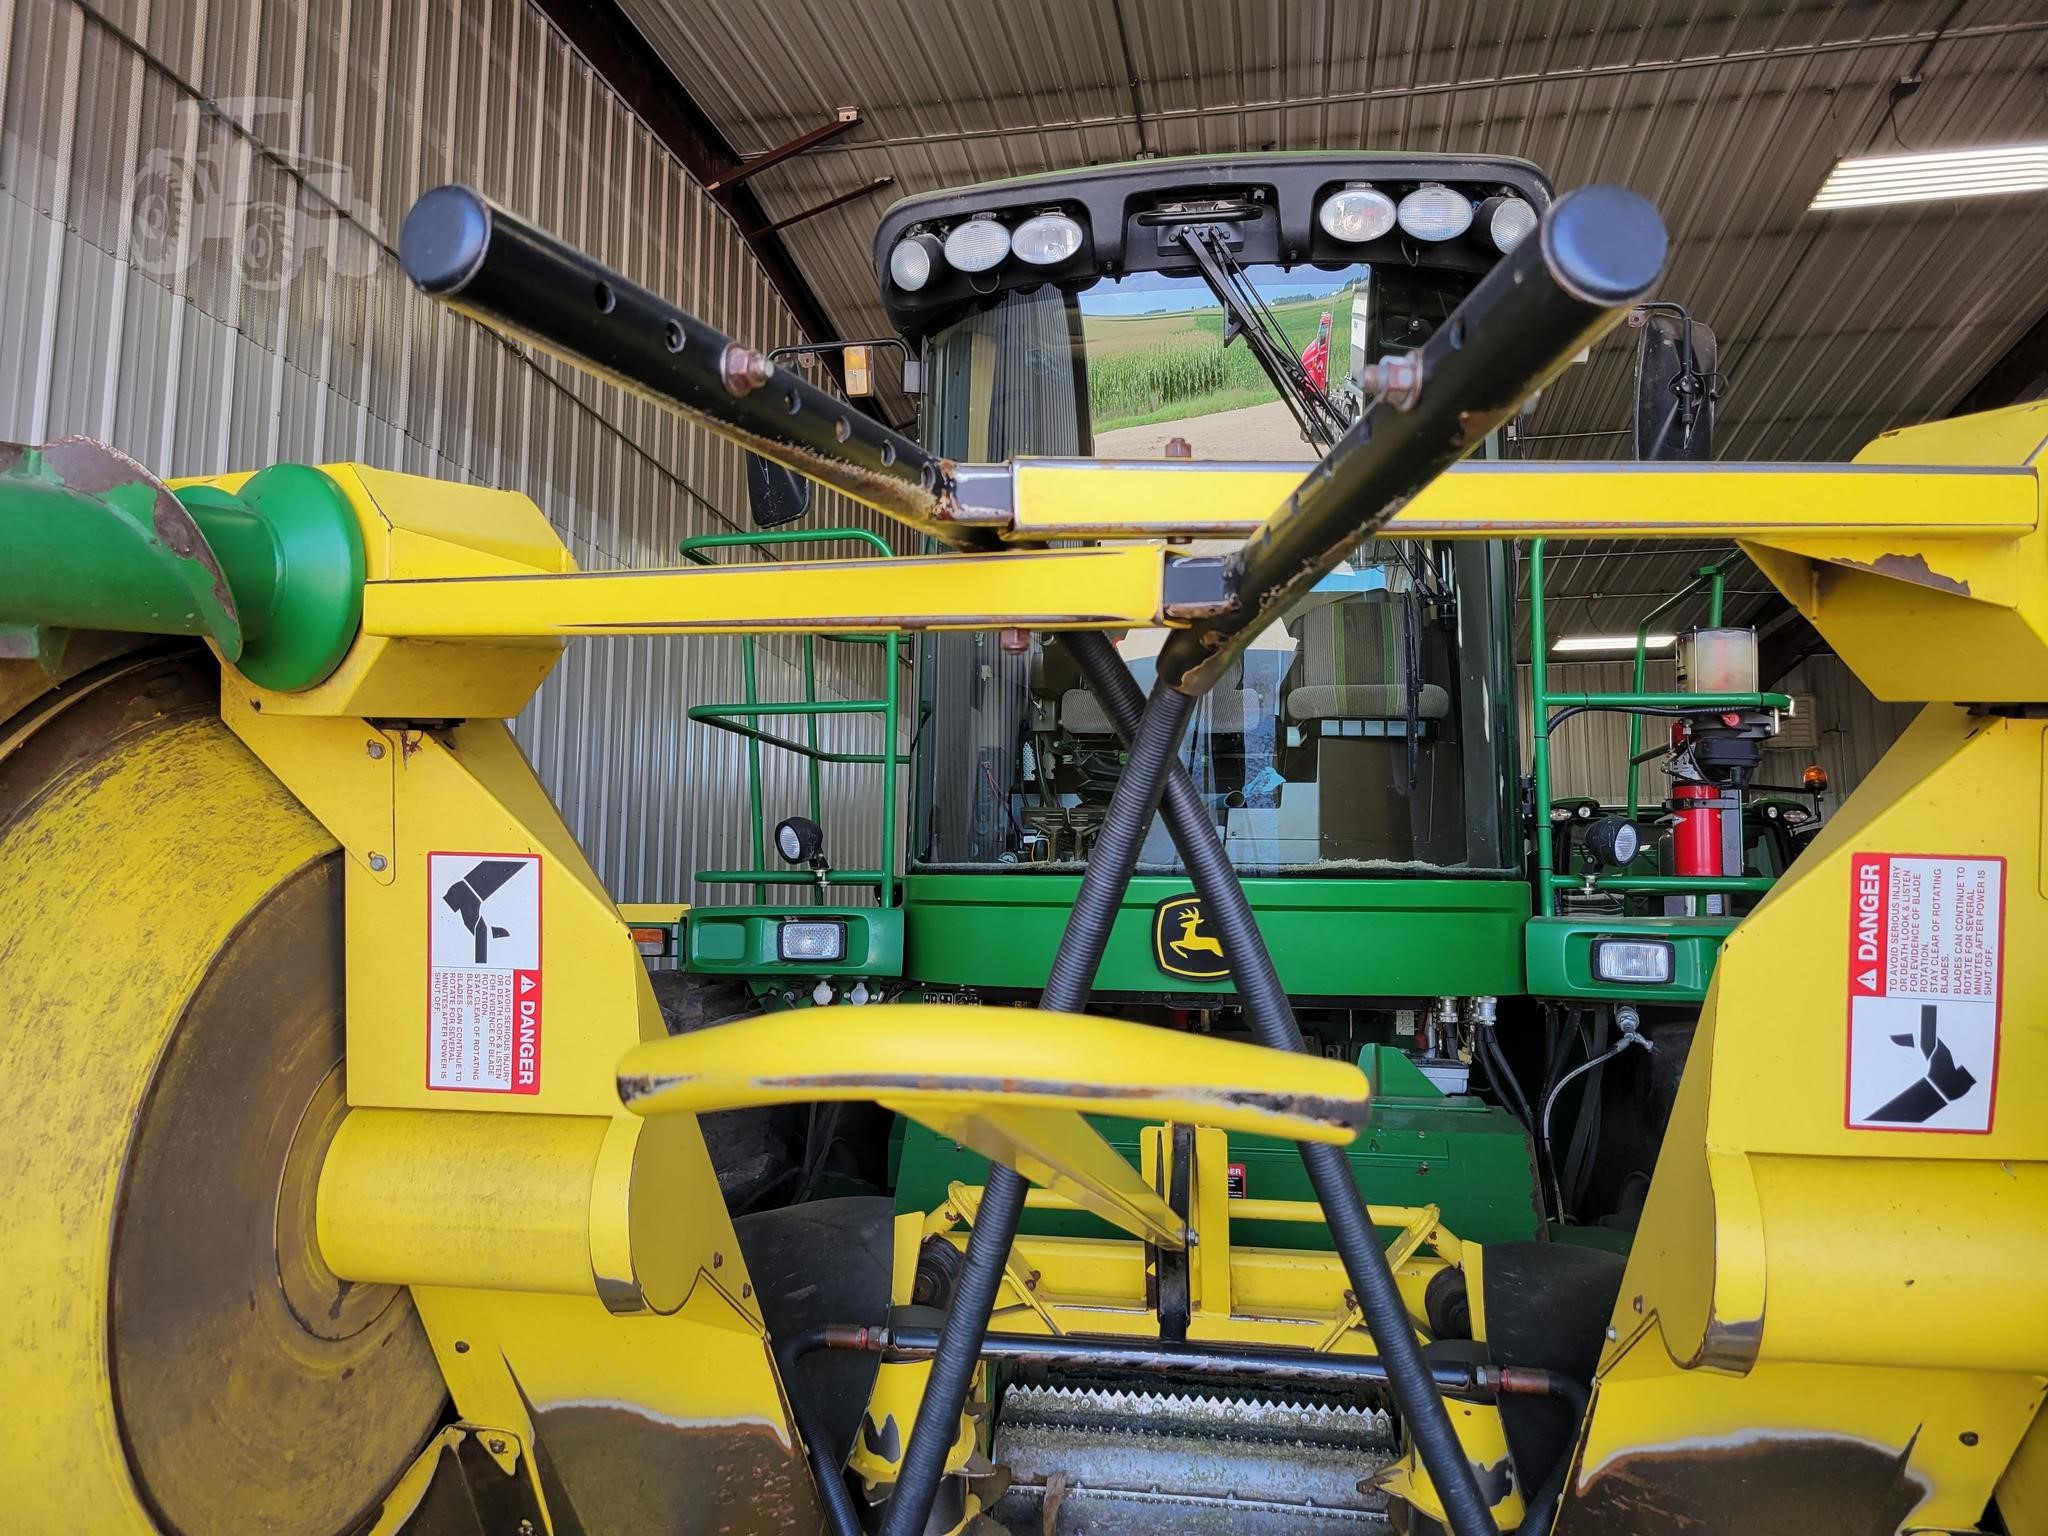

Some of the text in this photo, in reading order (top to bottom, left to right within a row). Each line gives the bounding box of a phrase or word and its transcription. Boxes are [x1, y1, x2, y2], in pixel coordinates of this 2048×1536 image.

[1903, 871, 1911, 902] LISTEN
[1957, 867, 1965, 878] TO
[1858, 865, 1880, 961] DANGER
[1955, 883, 1964, 931] CONTINUE
[1890, 866, 1901, 990] TO AVOID SERIOUS INJURY
[1901, 915, 1909, 940] LOOK
[1910, 874, 1921, 992] FOR EVIDENCE OF BLADE
[1930, 869, 1941, 992] STAY CLEAR OF ROTATING
[1964, 890, 1974, 994] ROTATE FOR SEVERAL
[1974, 870, 1985, 995] MINUTES AFTER POWER IS
[1900, 944, 1908, 976] DEATH
[1920, 942, 1929, 992] ROTATION.
[1941, 954, 1949, 993] BLADES.
[1954, 958, 1962, 994] BLADES
[1984, 947, 1993, 995] SHUT OFF.
[497, 975, 503, 986] OR
[505, 974, 511, 985] TO
[1900, 978, 1907, 991] OR
[474, 1027, 479, 1037] OF
[489, 1036, 495, 1047] OF
[519, 1001, 535, 1085] DANGER
[441, 1071, 447, 1079] IS
[456, 1071, 461, 1081] TO
